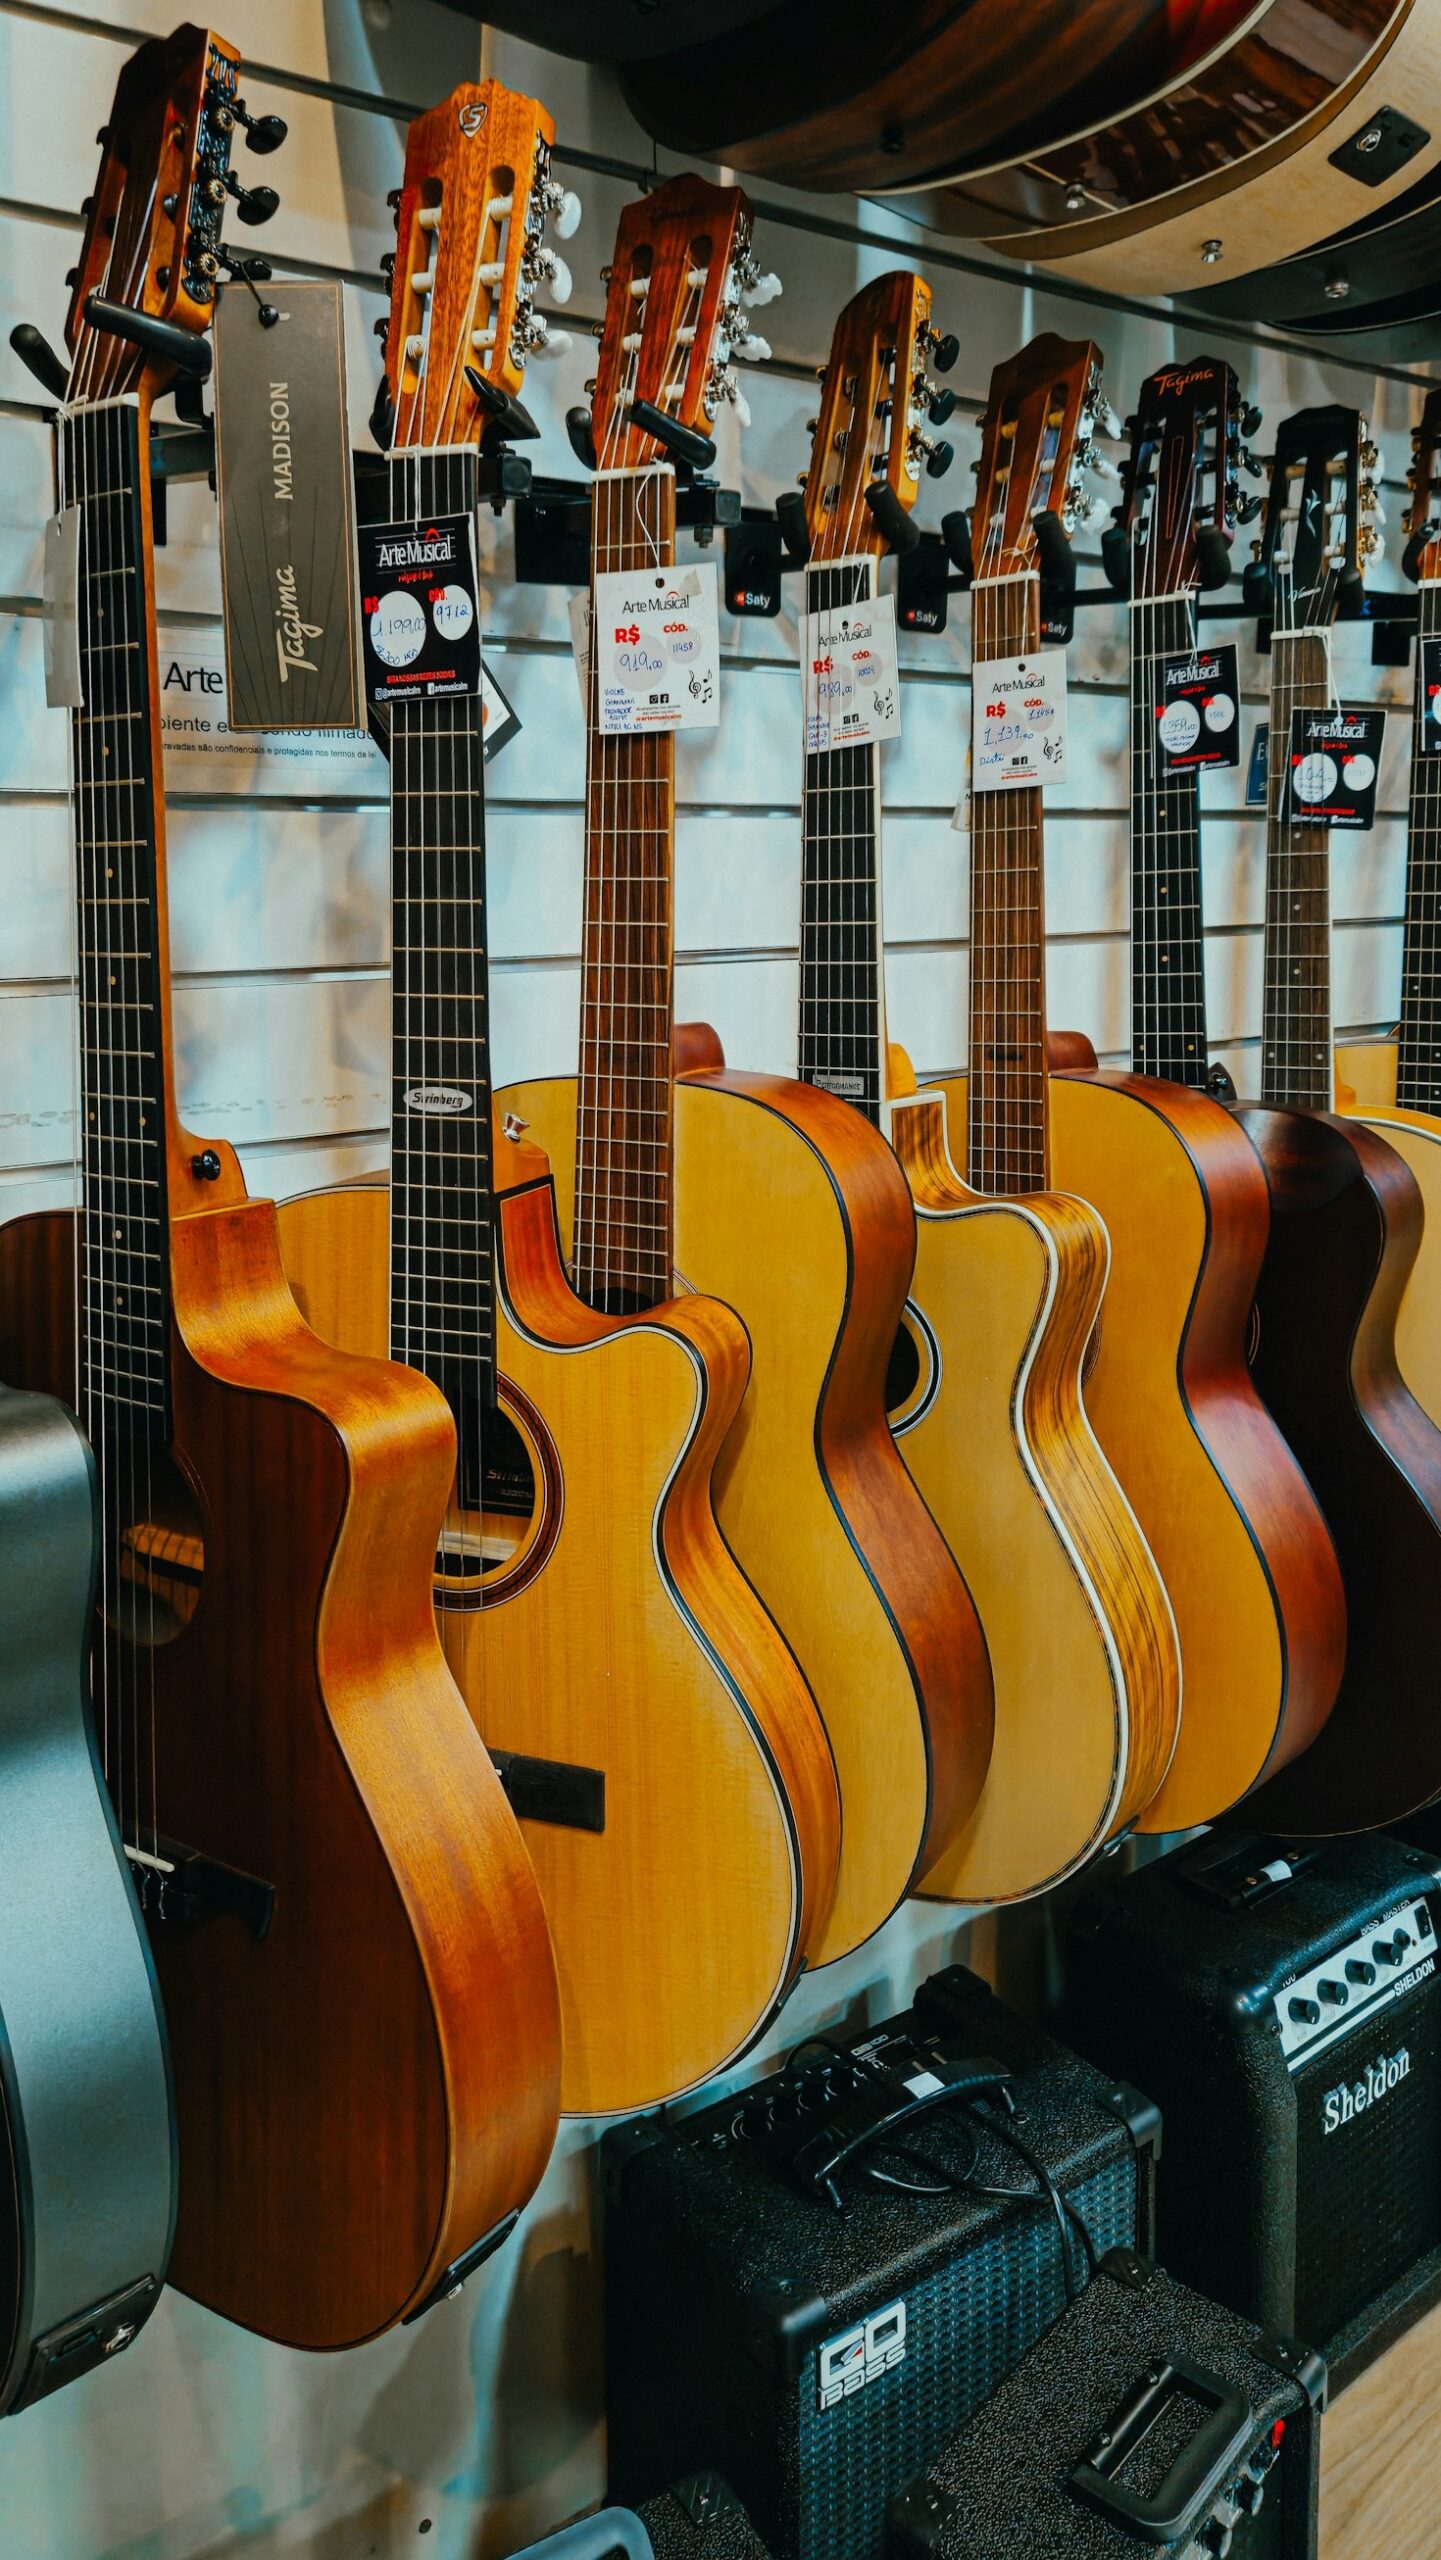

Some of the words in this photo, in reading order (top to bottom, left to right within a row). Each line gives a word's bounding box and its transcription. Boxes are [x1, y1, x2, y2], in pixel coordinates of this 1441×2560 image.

[1153, 368, 1214, 397] Tagima
[270, 381, 294, 501] MADISON
[379, 544, 406, 568] Arte
[407, 534, 452, 565] Musical
[622, 601, 647, 614] Arte
[649, 594, 690, 611] Musical
[746, 592, 771, 609] Saty
[276, 564, 324, 683] Tagima
[916, 610, 938, 626] Saty
[1047, 622, 1067, 636] Saty
[614, 624, 640, 645] R$
[663, 622, 688, 633] CÓD.
[839, 624, 873, 642] Musical
[813, 656, 834, 674] R$
[852, 650, 872, 661] CÓD.
[1166, 669, 1187, 686] Arte
[1187, 660, 1220, 683] Musical
[163, 662, 223, 693] Arte
[992, 682, 1012, 693] Arte
[1012, 676, 1045, 690] Musical
[986, 701, 1006, 719] R$
[1024, 698, 1044, 708] CÓD.
[1329, 721, 1365, 739] Musical
[163, 742, 196, 752] ravadas
[198, 742, 213, 752] são
[214, 743, 265, 755] confidenciais
[274, 747, 313, 758] protegidas
[315, 750, 329, 758] nos
[330, 749, 356, 759] termos
[1394, 1957, 1436, 1997] SHELDON
[1323, 2048, 1411, 2135] Sheldon
